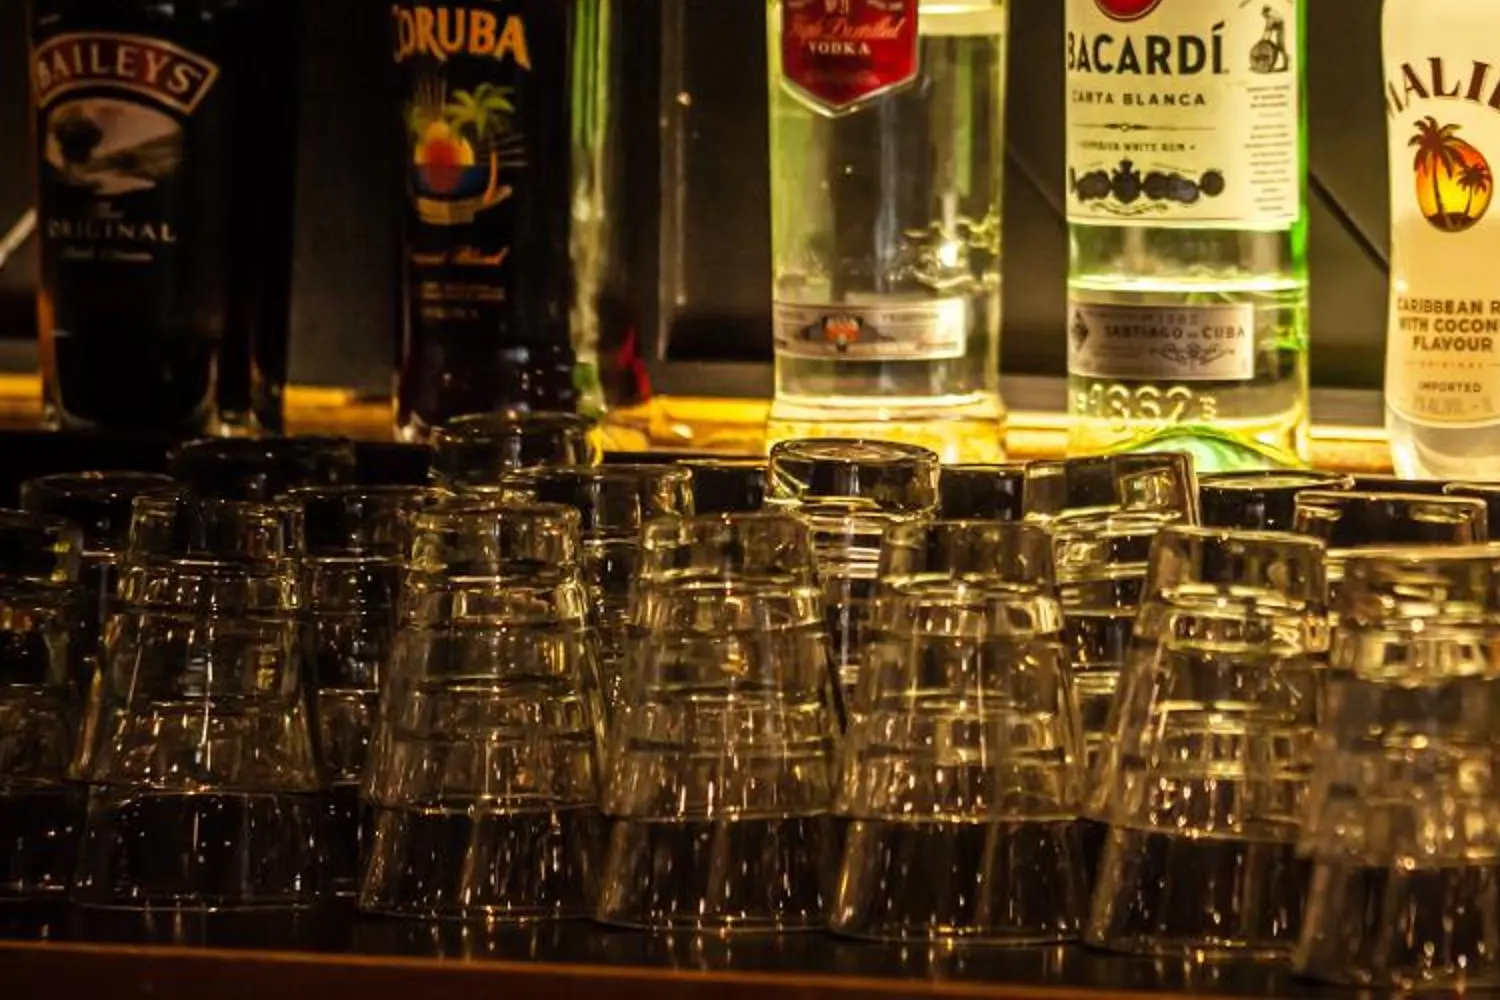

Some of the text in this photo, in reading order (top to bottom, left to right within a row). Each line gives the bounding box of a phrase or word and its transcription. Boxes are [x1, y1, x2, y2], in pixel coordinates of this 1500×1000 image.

[393, 3, 531, 71] ORUBA
[808, 41, 872, 56] VODKA
[1122, 92, 1207, 106] BLANCA
[1201, 326, 1246, 339] CUBA
[1412, 336, 1494, 352] FLAVOUR
